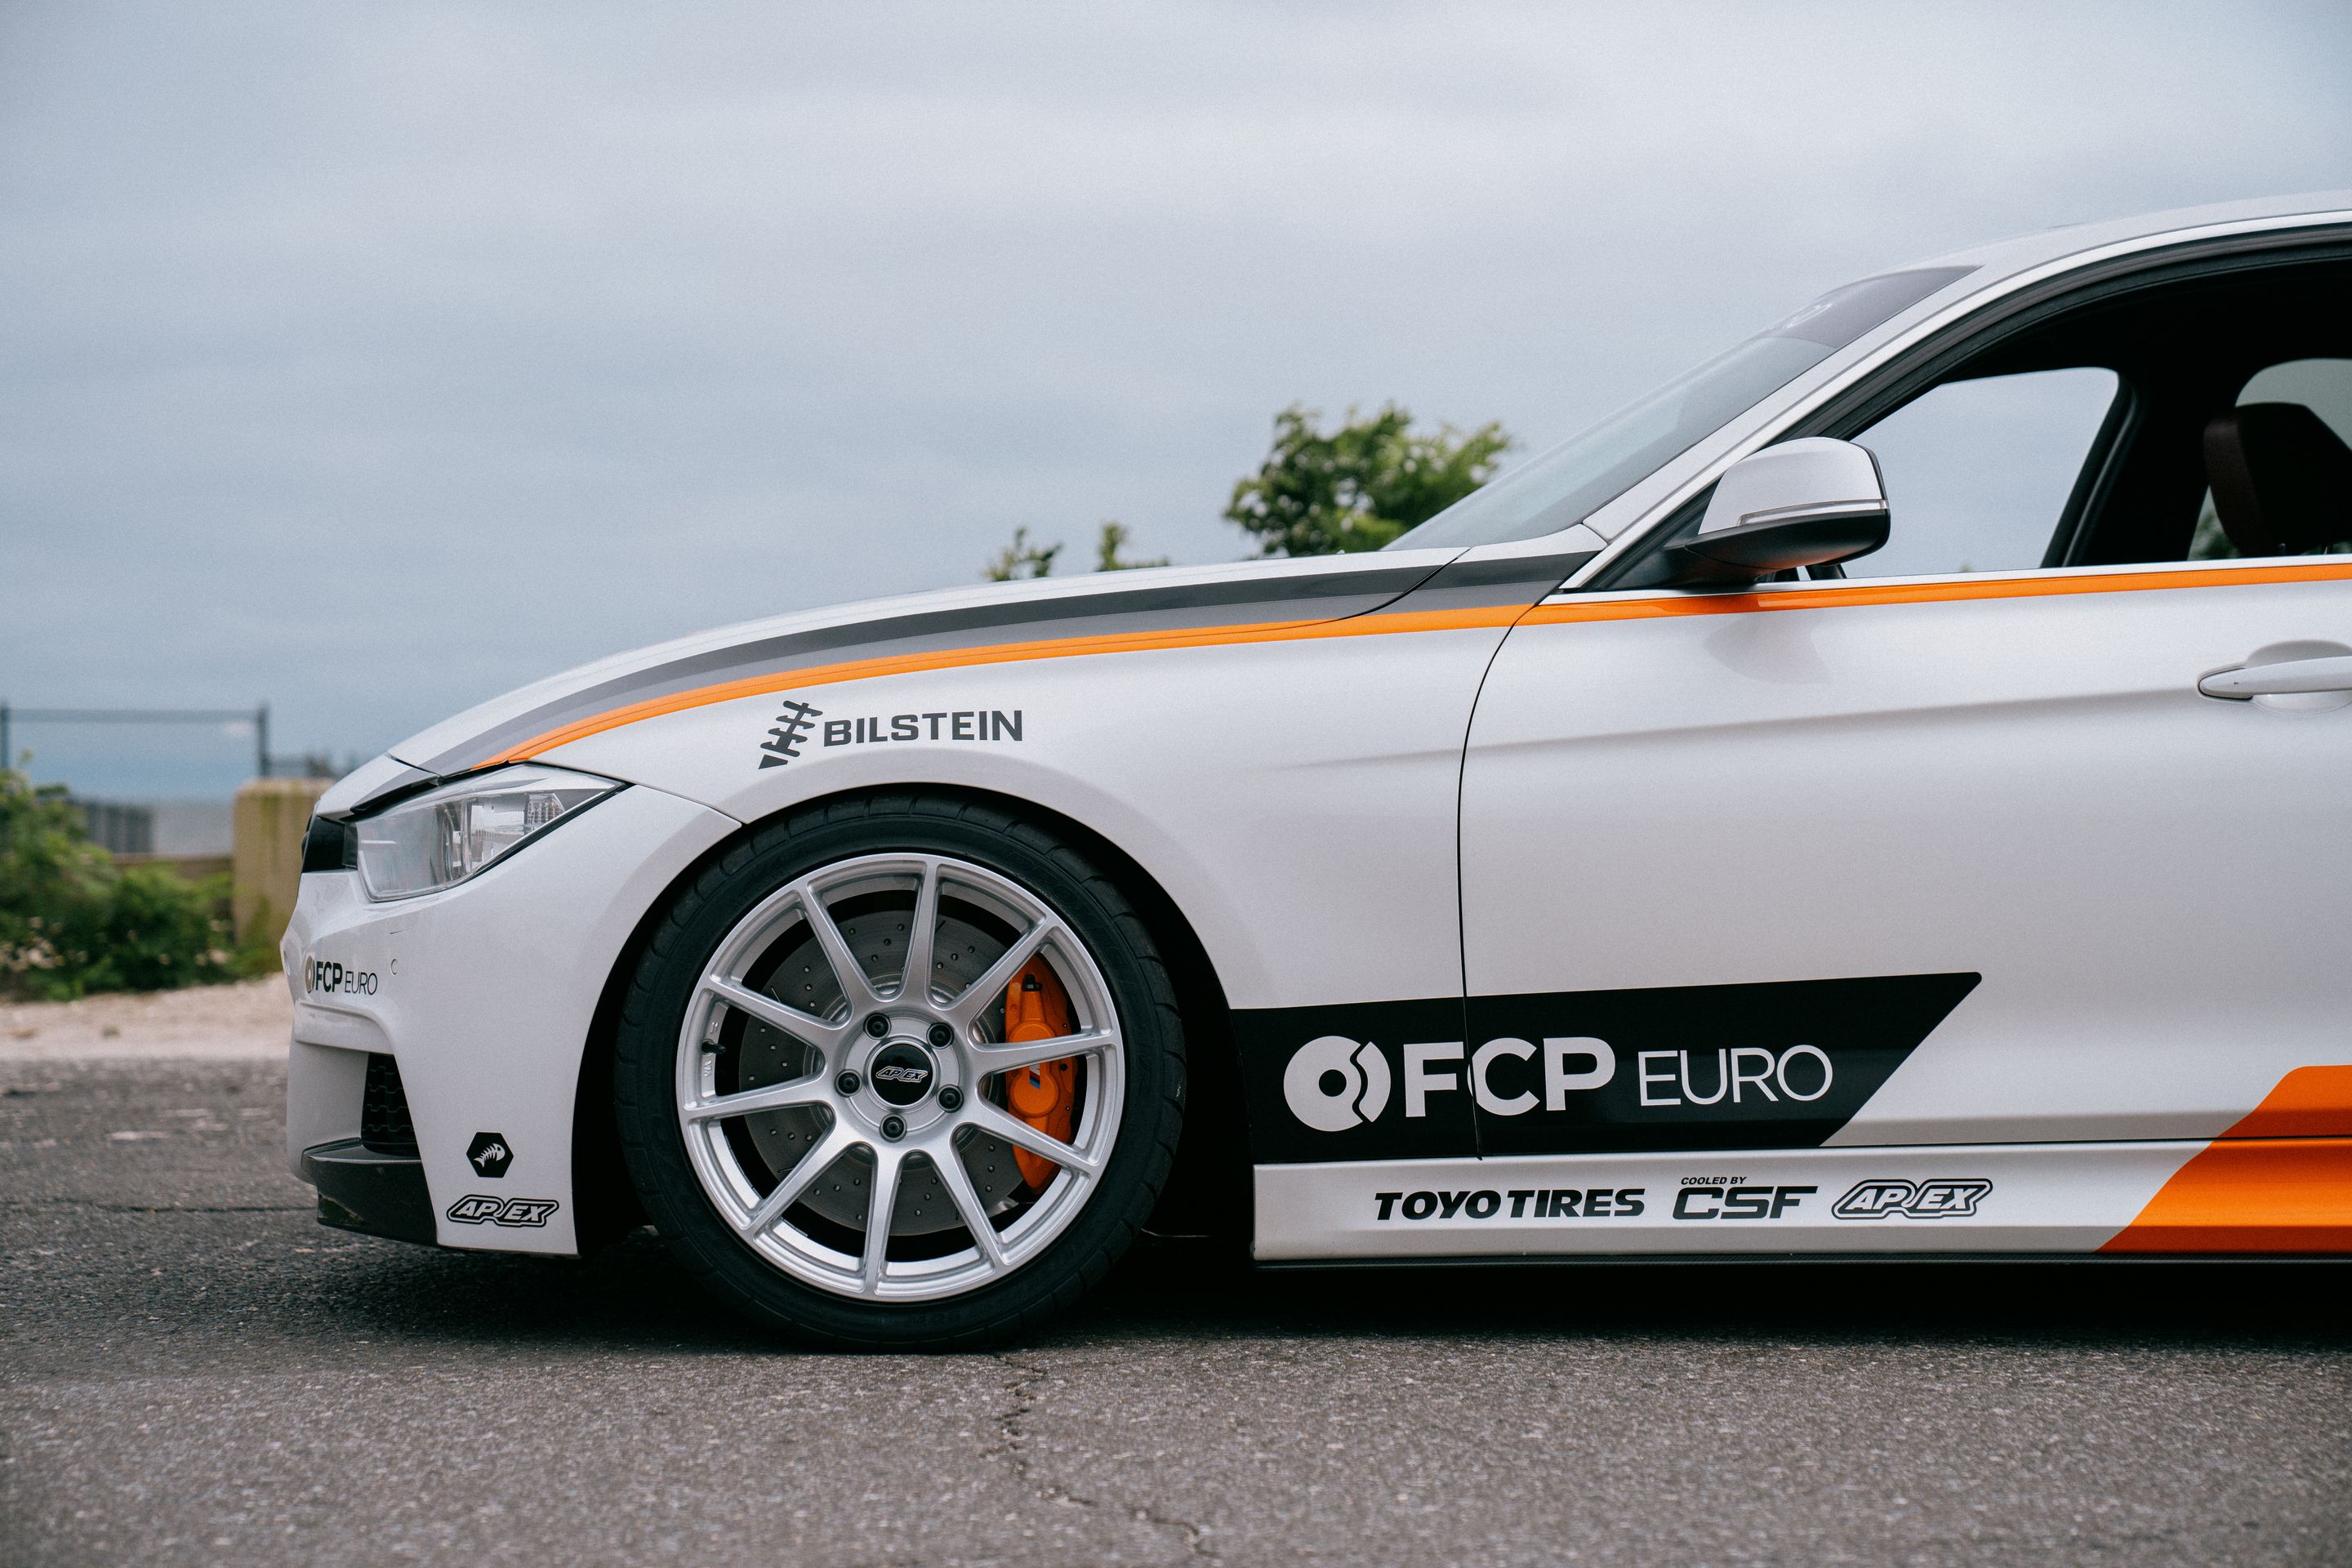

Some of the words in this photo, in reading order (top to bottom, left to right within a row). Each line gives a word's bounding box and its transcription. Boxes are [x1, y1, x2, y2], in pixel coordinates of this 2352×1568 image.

[824, 710, 1022, 747] BILSTEIN
[315, 960, 343, 993] FCP
[345, 970, 378, 996] EURO
[877, 1067, 926, 1082] APEX
[1403, 1036, 1616, 1118] FCP
[1637, 1044, 1833, 1107] EURO
[1681, 1177, 1727, 1185] COOLED
[1730, 1176, 1748, 1184] BY
[449, 1196, 555, 1226] APEX
[1374, 1189, 1501, 1221] TOYO
[1507, 1188, 1646, 1218] TIRES
[1673, 1185, 1819, 1220] CSF
[1838, 1183, 1985, 1215] APEX
